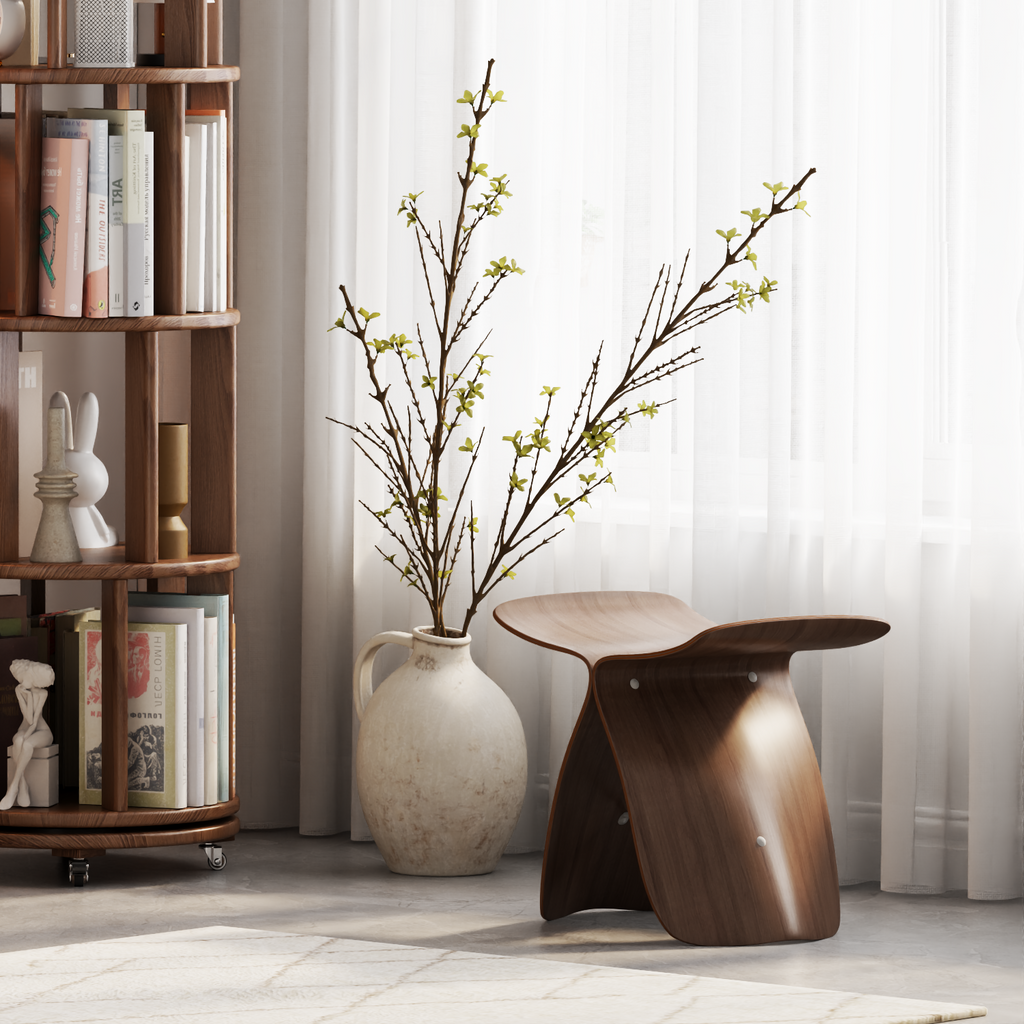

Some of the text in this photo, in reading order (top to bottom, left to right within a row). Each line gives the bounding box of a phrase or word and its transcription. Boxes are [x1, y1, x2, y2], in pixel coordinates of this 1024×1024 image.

[98, 136, 106, 172] HINTON
[98, 199, 106, 261] THE OUTSIDERS
